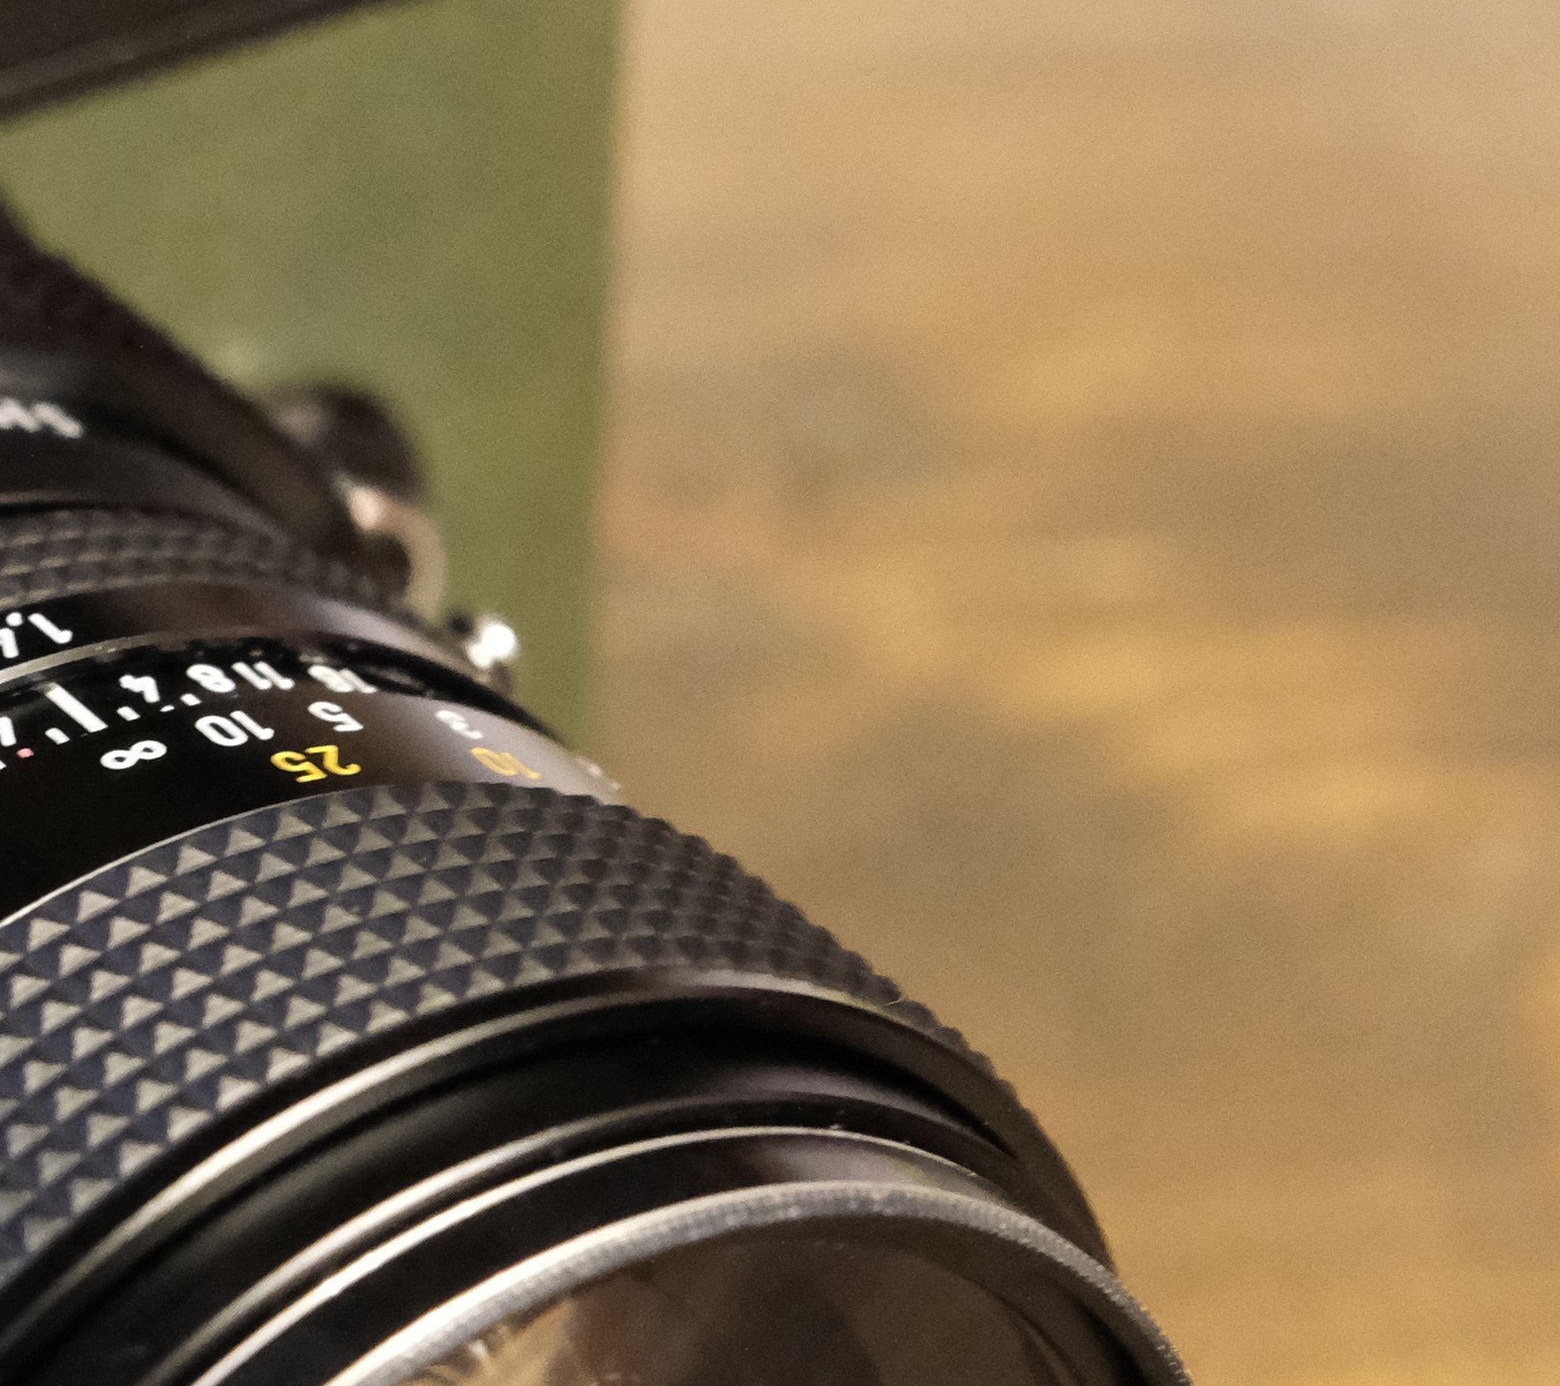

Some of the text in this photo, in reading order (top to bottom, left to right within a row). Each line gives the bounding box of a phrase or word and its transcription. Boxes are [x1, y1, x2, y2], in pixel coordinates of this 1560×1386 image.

[119, 674, 160, 703] 4
[186, 663, 236, 694] 8
[194, 710, 275, 746] 10
[308, 701, 364, 732] 5
[270, 744, 361, 782] 25
